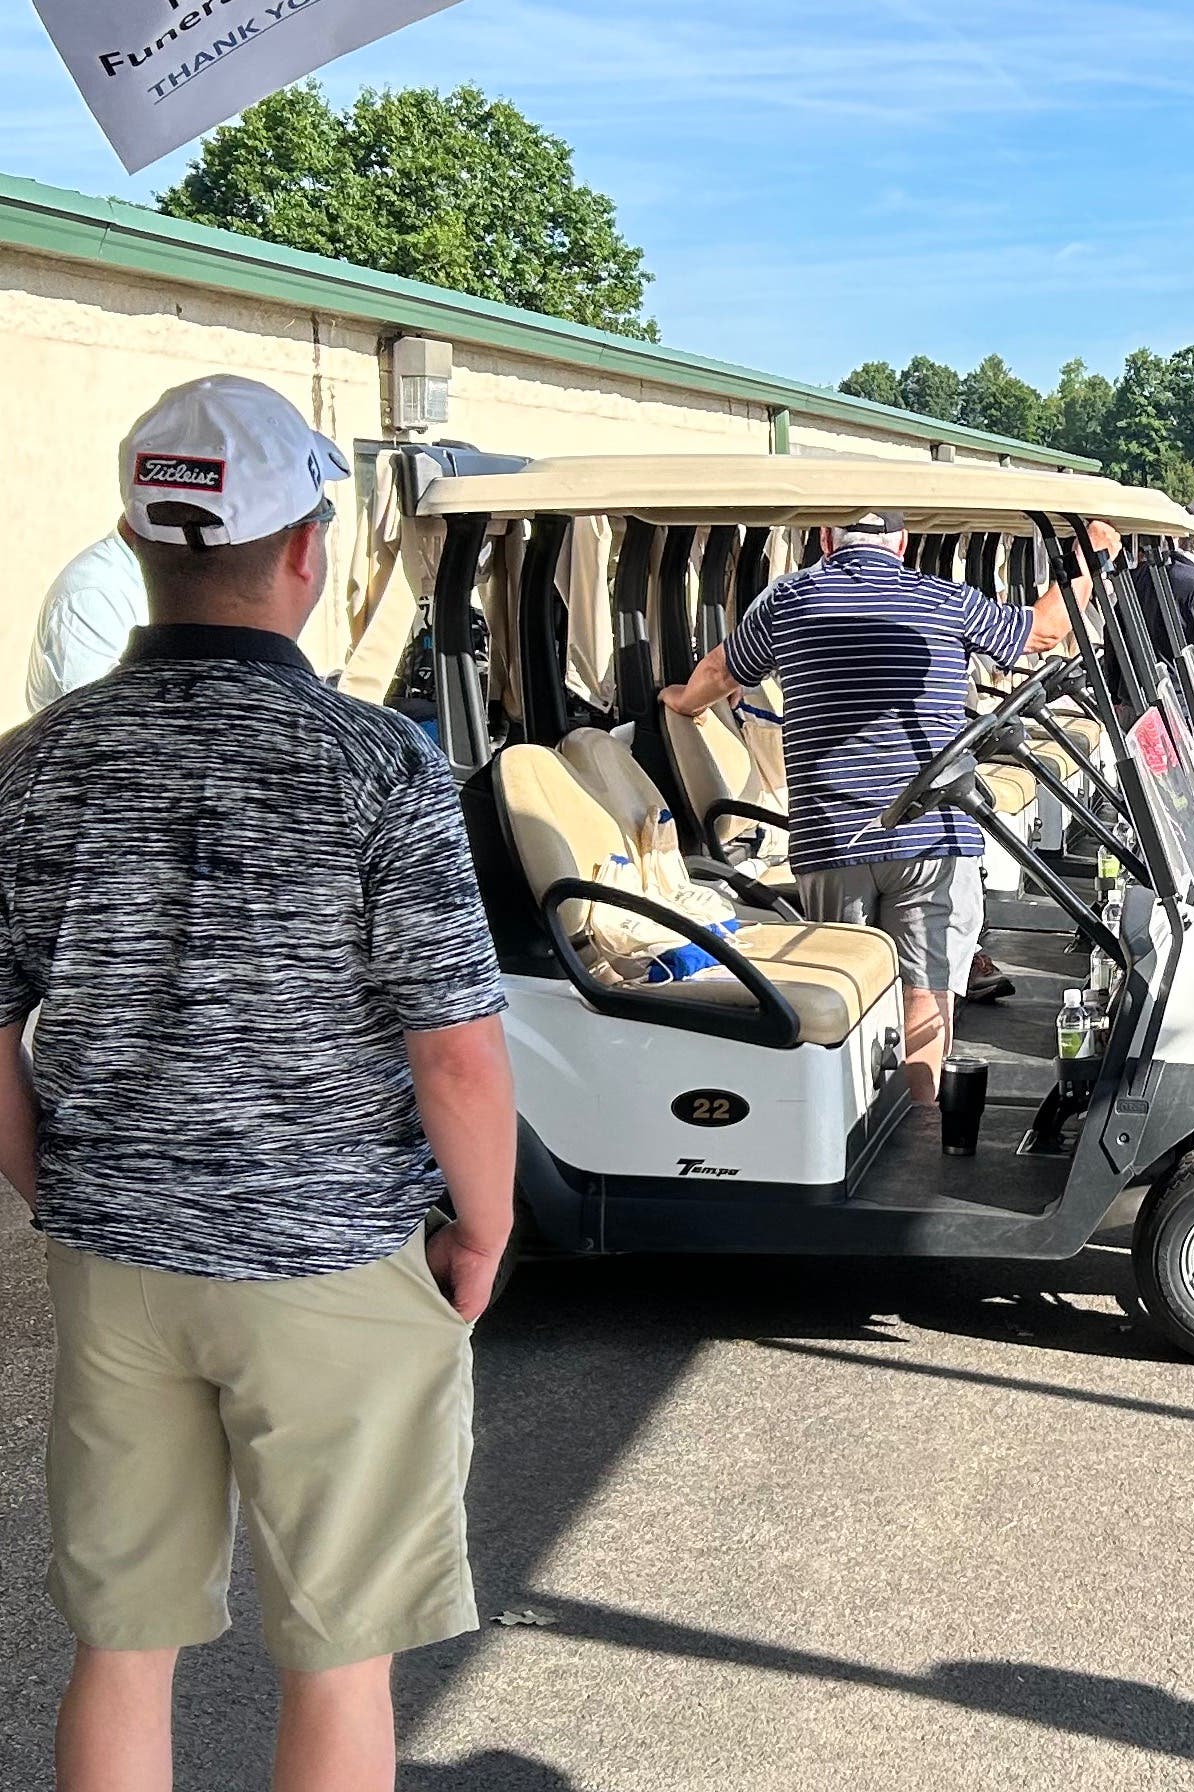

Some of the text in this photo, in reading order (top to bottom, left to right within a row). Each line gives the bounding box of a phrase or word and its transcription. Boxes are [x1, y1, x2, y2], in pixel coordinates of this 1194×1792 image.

[99, 0, 232, 76] Funer
[147, 18, 260, 97] THANK
[139, 460, 219, 485] Titleist
[693, 1098, 730, 1119] 22
[676, 1158, 741, 1177] Tempo
